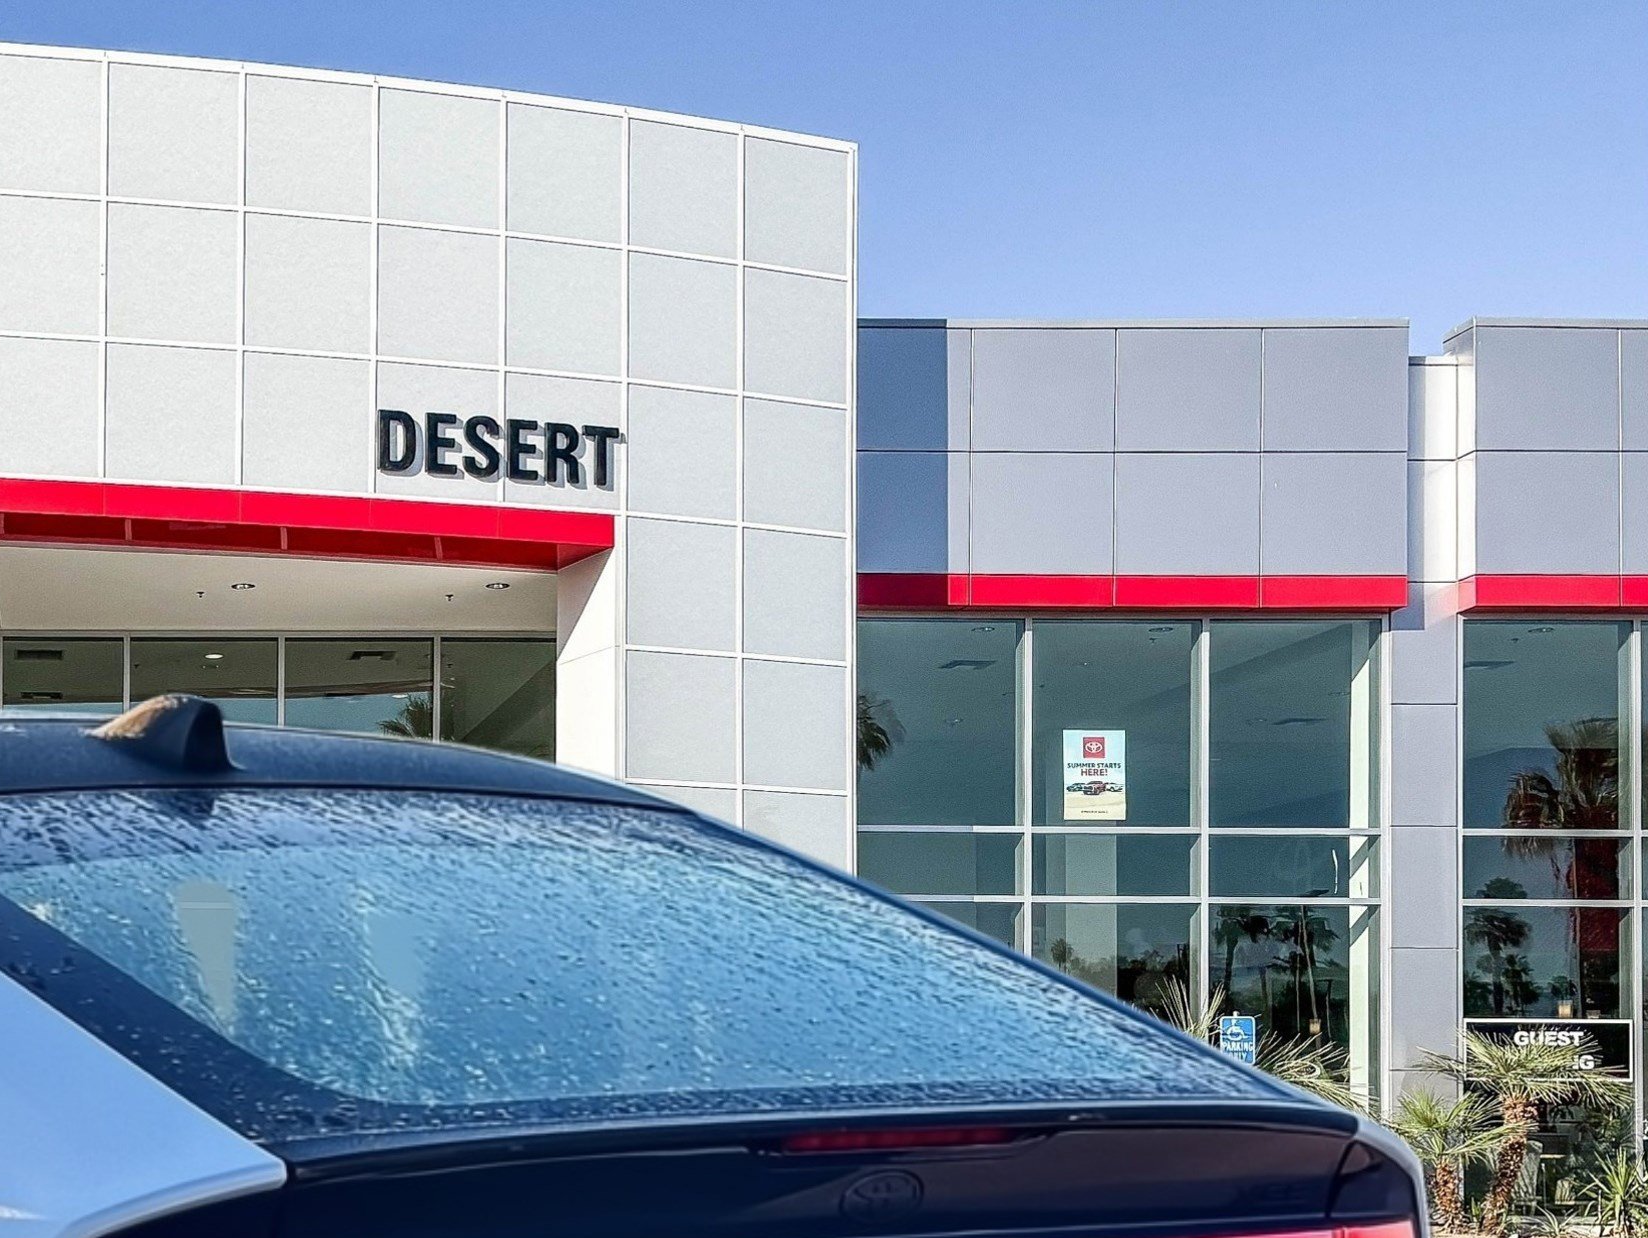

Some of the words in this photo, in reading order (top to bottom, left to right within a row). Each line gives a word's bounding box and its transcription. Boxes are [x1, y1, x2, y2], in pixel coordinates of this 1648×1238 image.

[377, 409, 619, 486] DESERT
[1080, 768, 1108, 776] HERE!
[1222, 1040, 1254, 1051] PARKING
[1513, 1031, 1584, 1047] GUEST
